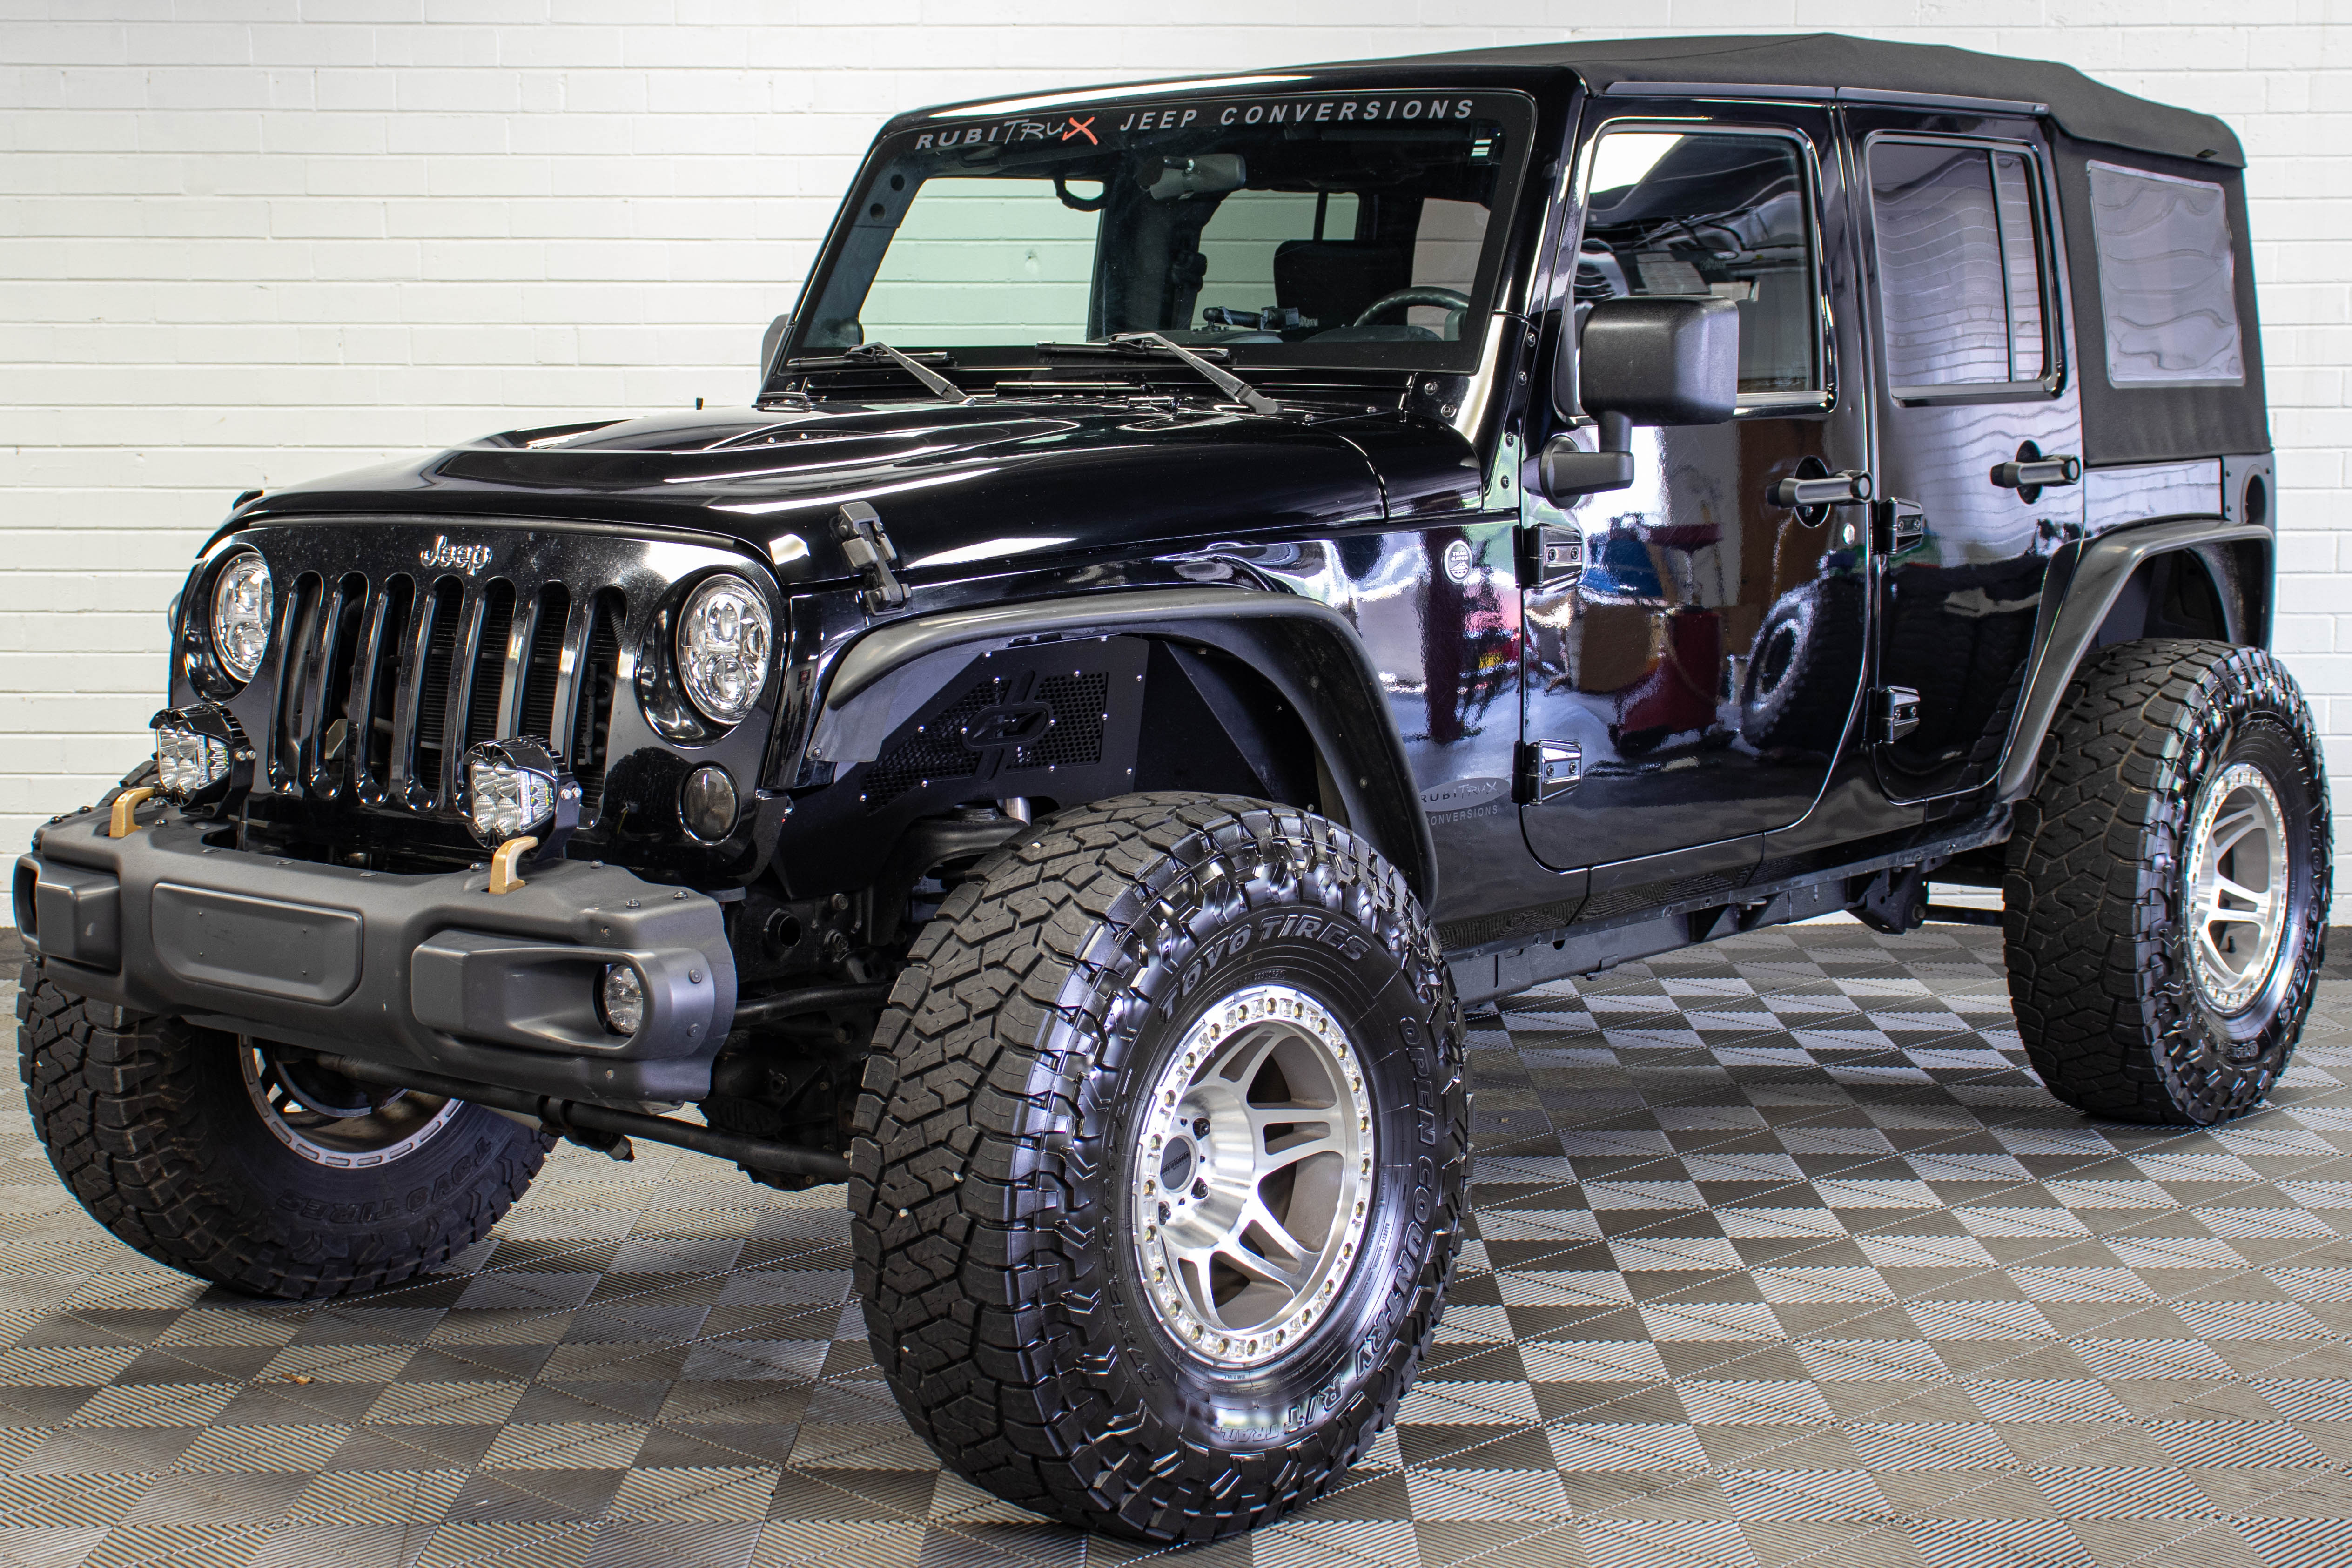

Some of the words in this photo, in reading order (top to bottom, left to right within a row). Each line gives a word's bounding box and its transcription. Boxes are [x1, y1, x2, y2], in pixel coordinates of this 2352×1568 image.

[1120, 109, 1197, 132] JEEP
[1220, 99, 1473, 125] CONVERSIONS
[420, 535, 493, 577] Jeep
[1159, 923, 1252, 1023] TOYO
[1259, 915, 1371, 961] TIRES
[1400, 1016, 1438, 1148] OPEN
[406, 1136, 492, 1212] TOYO
[276, 1189, 400, 1224] TIRES
[1356, 1155, 1434, 1380] COUNTRY
[1219, 1424, 1280, 1443] TRAIL
